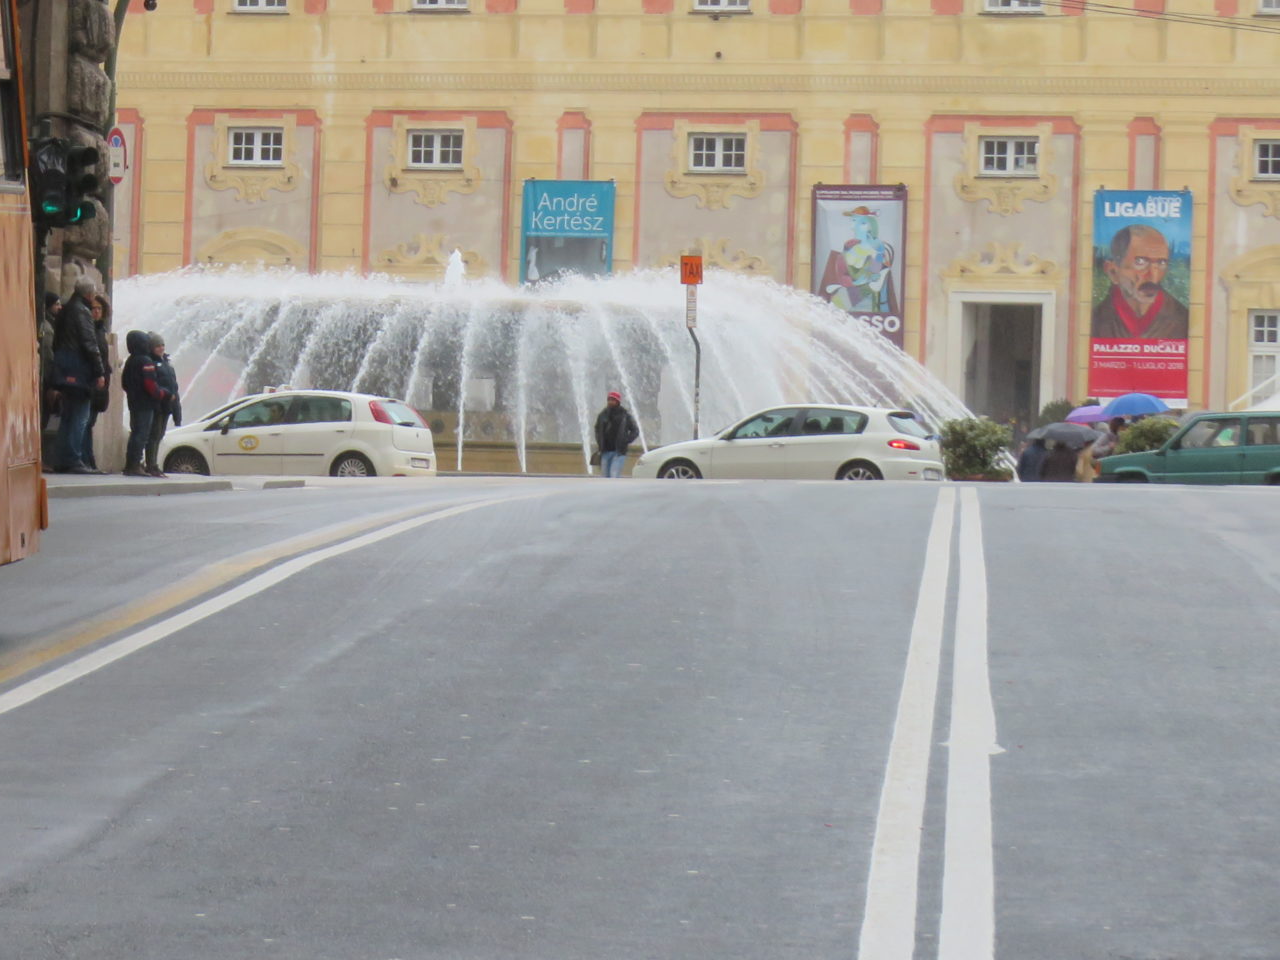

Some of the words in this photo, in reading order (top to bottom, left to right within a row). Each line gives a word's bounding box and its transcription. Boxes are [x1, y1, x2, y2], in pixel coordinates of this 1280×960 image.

[537, 192, 597, 211] André
[1104, 201, 1181, 217] LIGABUE
[531, 211, 604, 230] Kertész
[1093, 343, 1141, 352] PALAZZO
[1143, 344, 1185, 353] DUCALE
